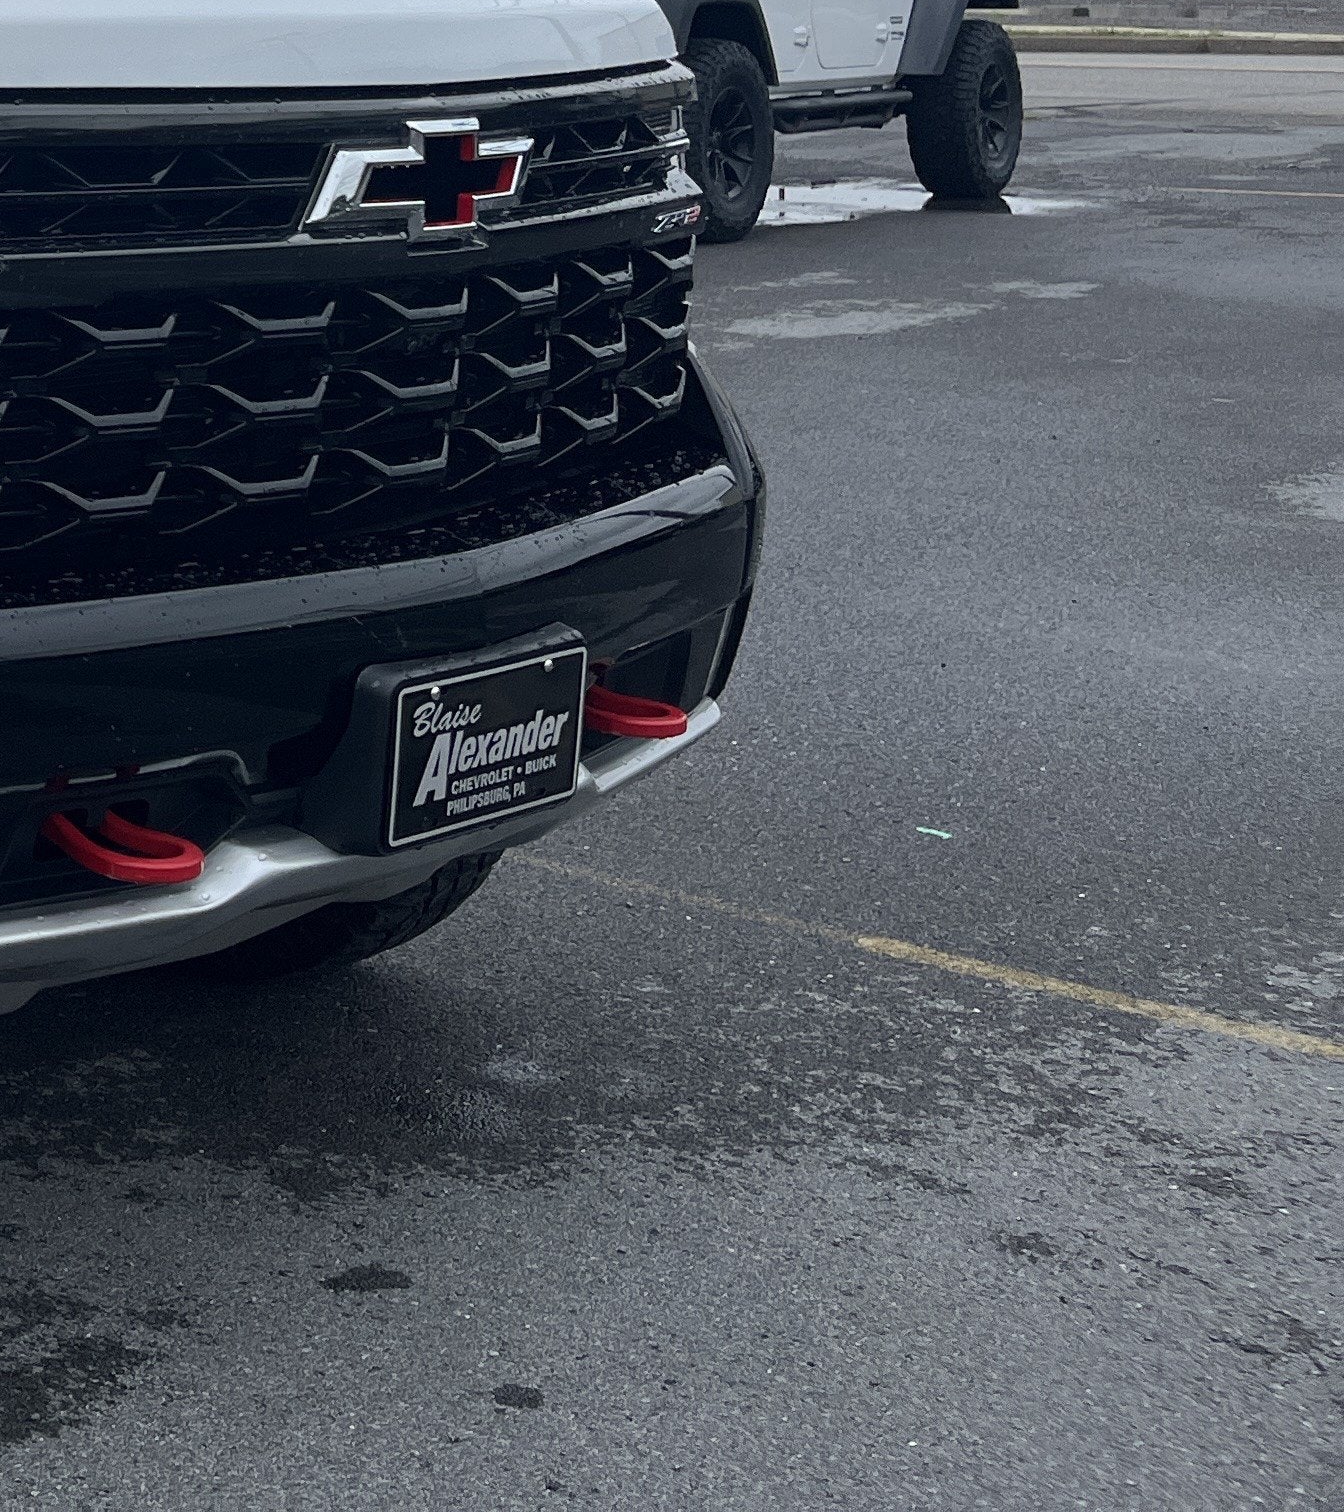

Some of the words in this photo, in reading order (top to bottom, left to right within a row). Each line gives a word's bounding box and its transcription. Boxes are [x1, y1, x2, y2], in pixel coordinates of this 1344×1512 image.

[413, 701, 482, 737] Blaise
[413, 709, 569, 807] Alexander
[451, 766, 514, 795] CHEVROLET
[524, 754, 557, 775] BUICK
[446, 785, 512, 816] PHILIPSBURG,
[513, 781, 526, 798] PA
